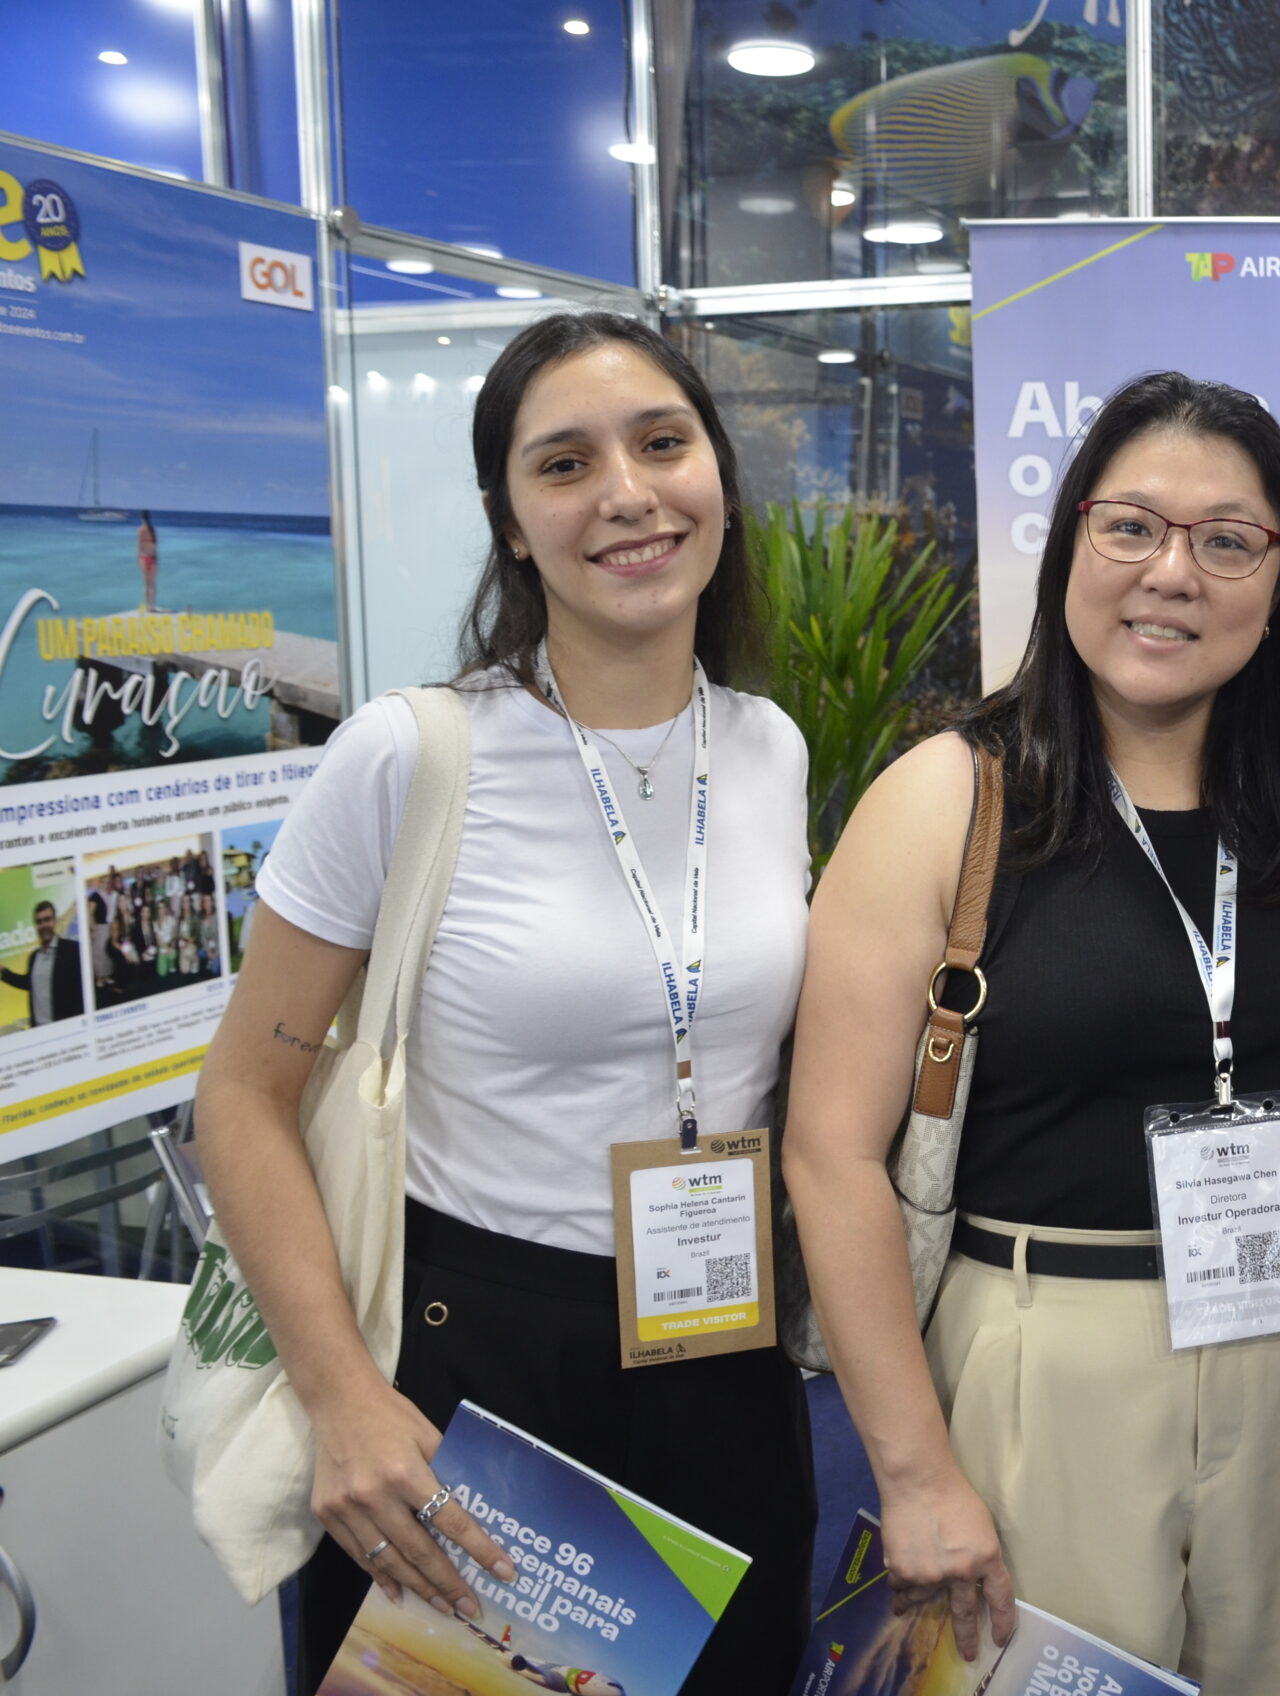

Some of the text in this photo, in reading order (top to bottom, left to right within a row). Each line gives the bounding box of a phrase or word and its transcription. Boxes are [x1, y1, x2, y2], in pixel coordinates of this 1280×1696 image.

[32, 194, 66, 224] 20
[250, 257, 305, 298] GOL
[1185, 252, 1236, 282] TAP
[1009, 454, 1052, 497] o
[37, 604, 275, 661] UM PARAÍSO CHAMADO
[0, 794, 102, 825] mpressiona
[107, 789, 141, 807] com
[146, 778, 210, 801] cenários
[213, 773, 231, 791] de
[235, 770, 265, 789] tirar
[269, 770, 278, 783] o
[591, 768, 619, 827] ILHABELA
[695, 789, 706, 845] ILHABELA
[1221, 901, 1233, 951] ILHABELA
[1192, 930, 1213, 983] ILHABEL
[662, 962, 683, 1026] ILHABELA
[727, 1136, 761, 1150] wtm
[1217, 1142, 1250, 1157] wtm
[688, 1174, 722, 1187] wtm
[1175, 1169, 1278, 1190] Silvia Hasegawa Chen
[649, 1194, 746, 1213] Sophia Helena Cantarin
[680, 1207, 716, 1218] Figueroa
[1210, 1192, 1247, 1204] Diretora
[646, 1215, 751, 1235] Assistente de atendimento
[1178, 1204, 1280, 1225] Investur Operadora
[677, 1233, 721, 1246] Investur
[690, 1249, 710, 1258] Brazil
[661, 1312, 747, 1331] TRADE VISITOR
[629, 1346, 673, 1360] ILHABELA
[452, 1483, 595, 1576] Abrace 96
[508, 1547, 637, 1626] semanais
[550, 1591, 620, 1642] para
[1043, 1644, 1057, 1661] o
[1056, 1654, 1080, 1685] do
